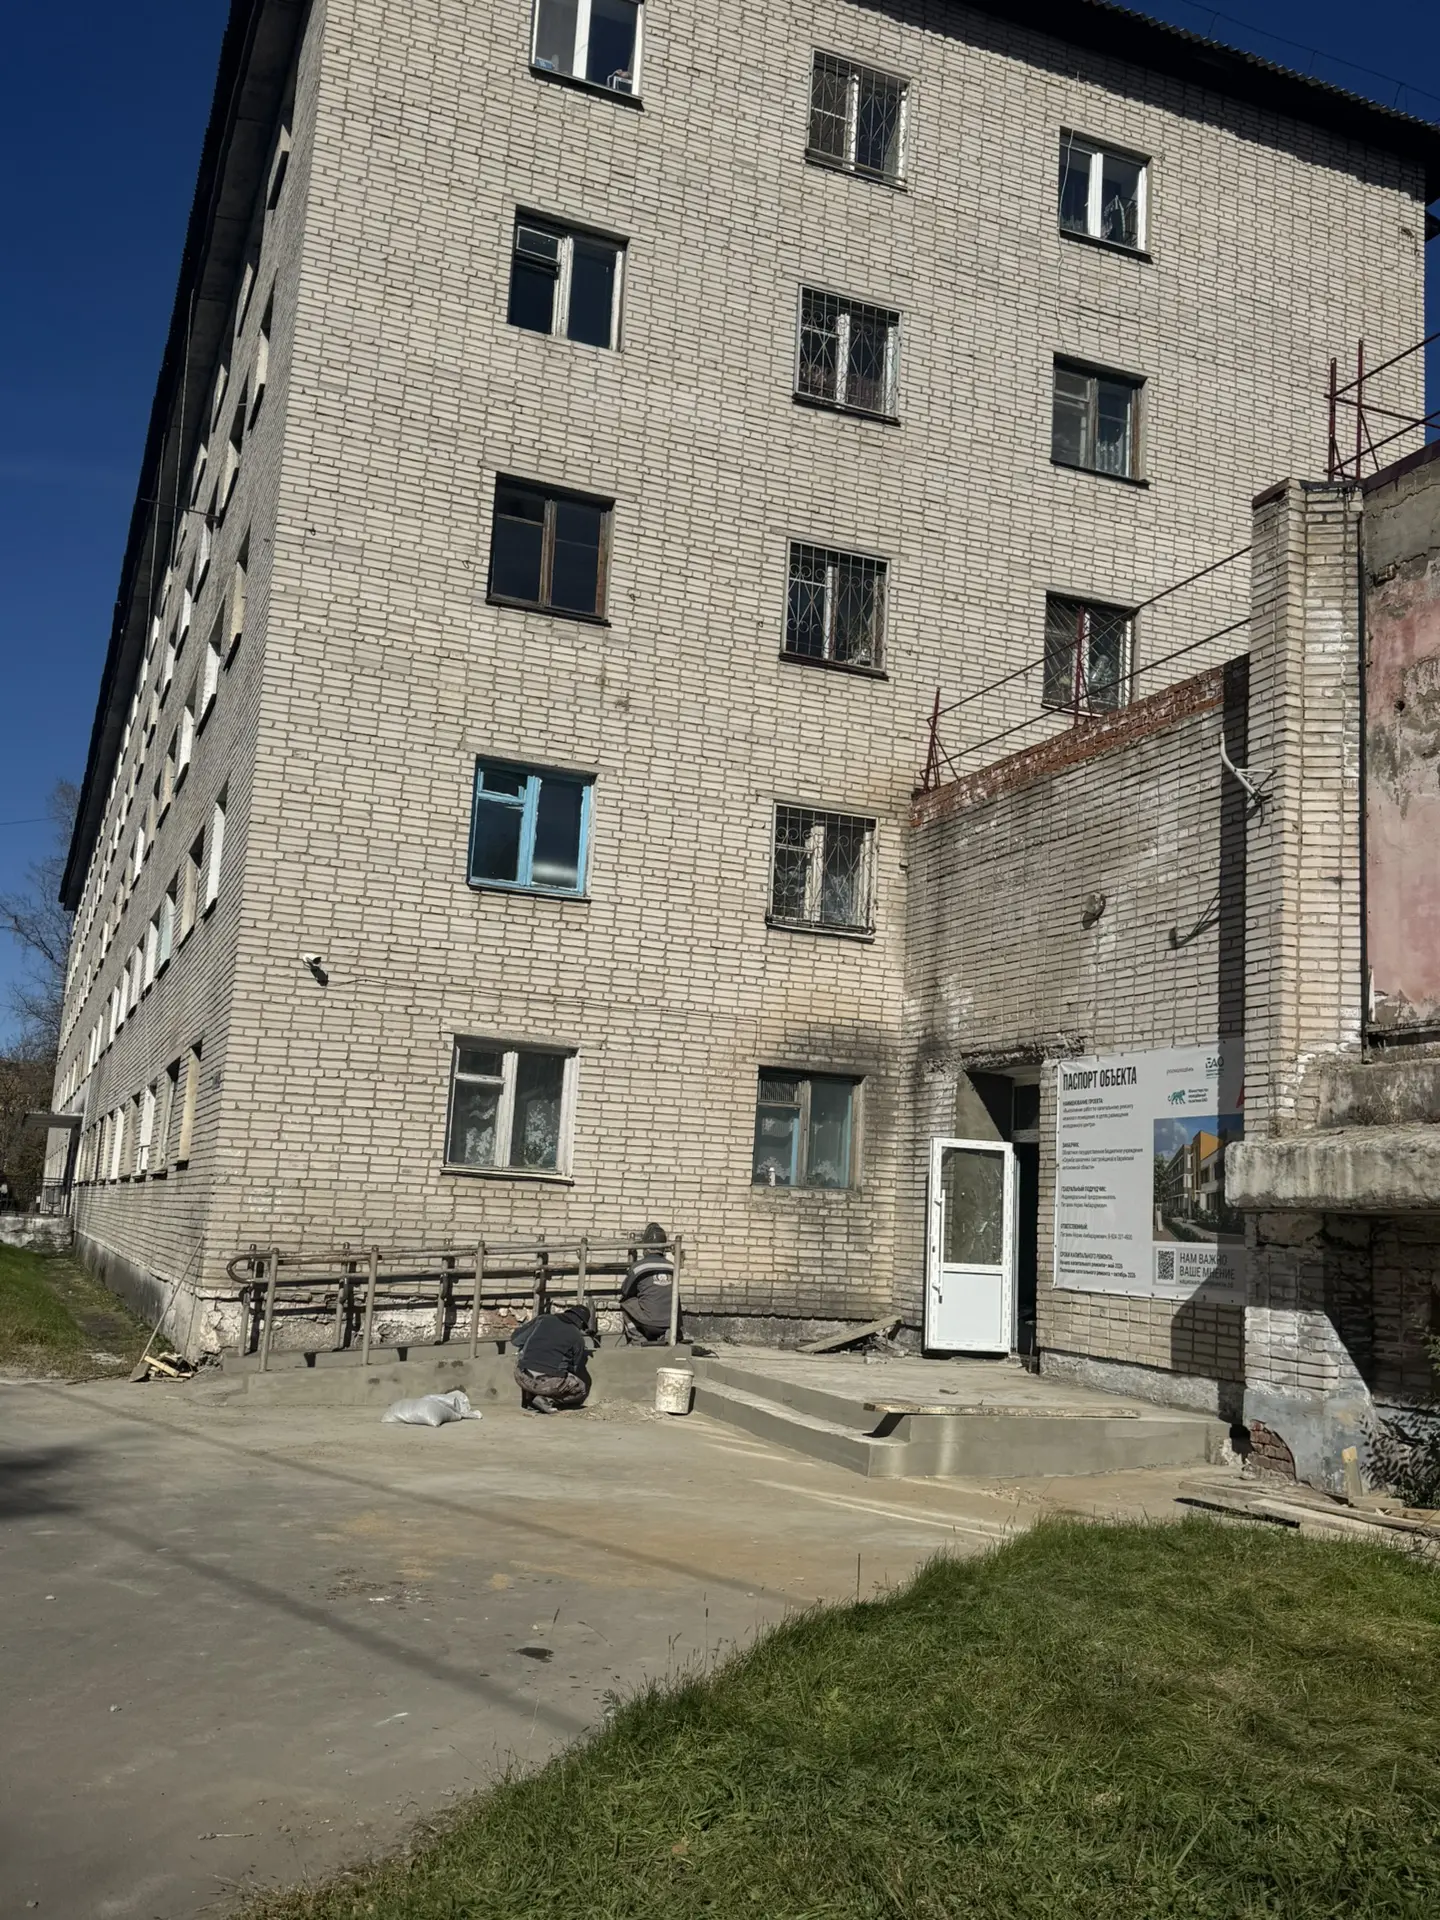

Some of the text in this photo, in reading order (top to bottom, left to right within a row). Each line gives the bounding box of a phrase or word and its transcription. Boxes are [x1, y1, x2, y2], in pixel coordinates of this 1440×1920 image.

[1063, 1066, 1137, 1091] ПАСПОРТ ОБЪЕКТА
[1179, 1252, 1228, 1266] НАМ ВАЖНО
[1179, 1265, 1236, 1280] ВАШЕ МНЕНИЕ
